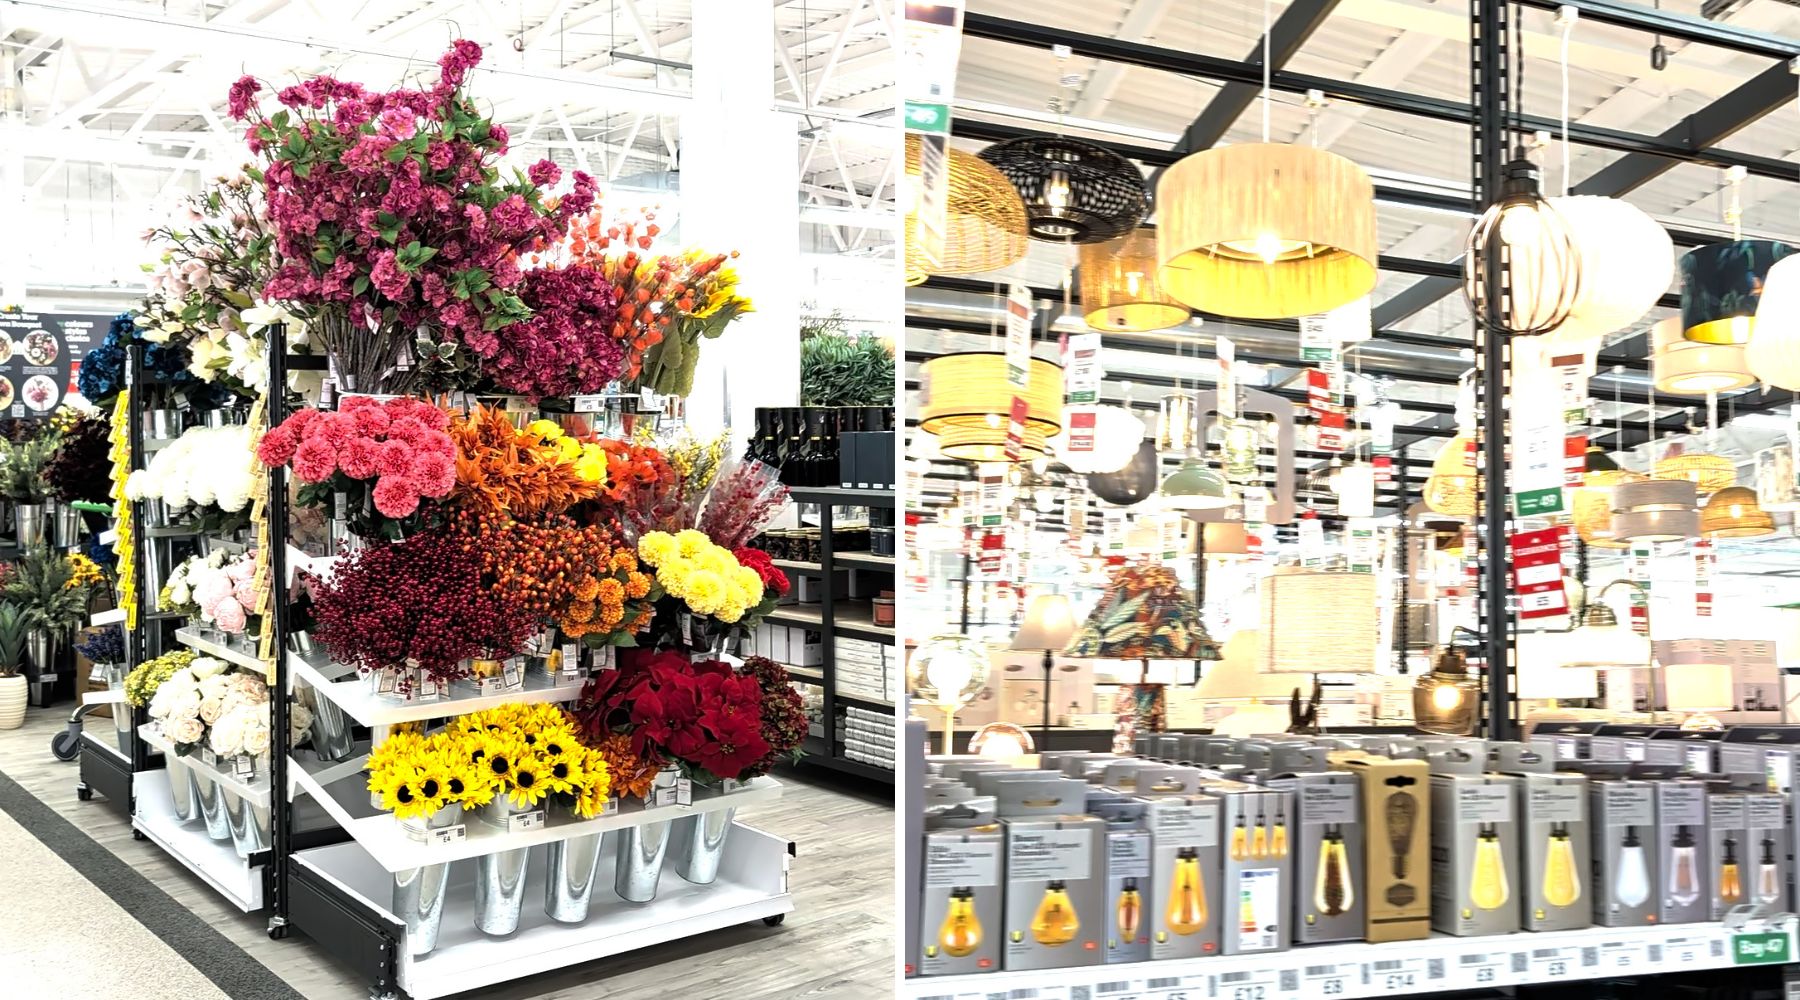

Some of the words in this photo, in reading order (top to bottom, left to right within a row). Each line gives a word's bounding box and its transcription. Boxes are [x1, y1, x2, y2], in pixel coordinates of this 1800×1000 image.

[443, 835, 451, 843] £4
[1739, 940, 1765, 957] Bay
[1476, 968, 1495, 982] £8
[1548, 962, 1567, 976] £8
[1323, 979, 1344, 995] £8
[1386, 974, 1415, 989] £14
[1234, 986, 1266, 1000] £12
